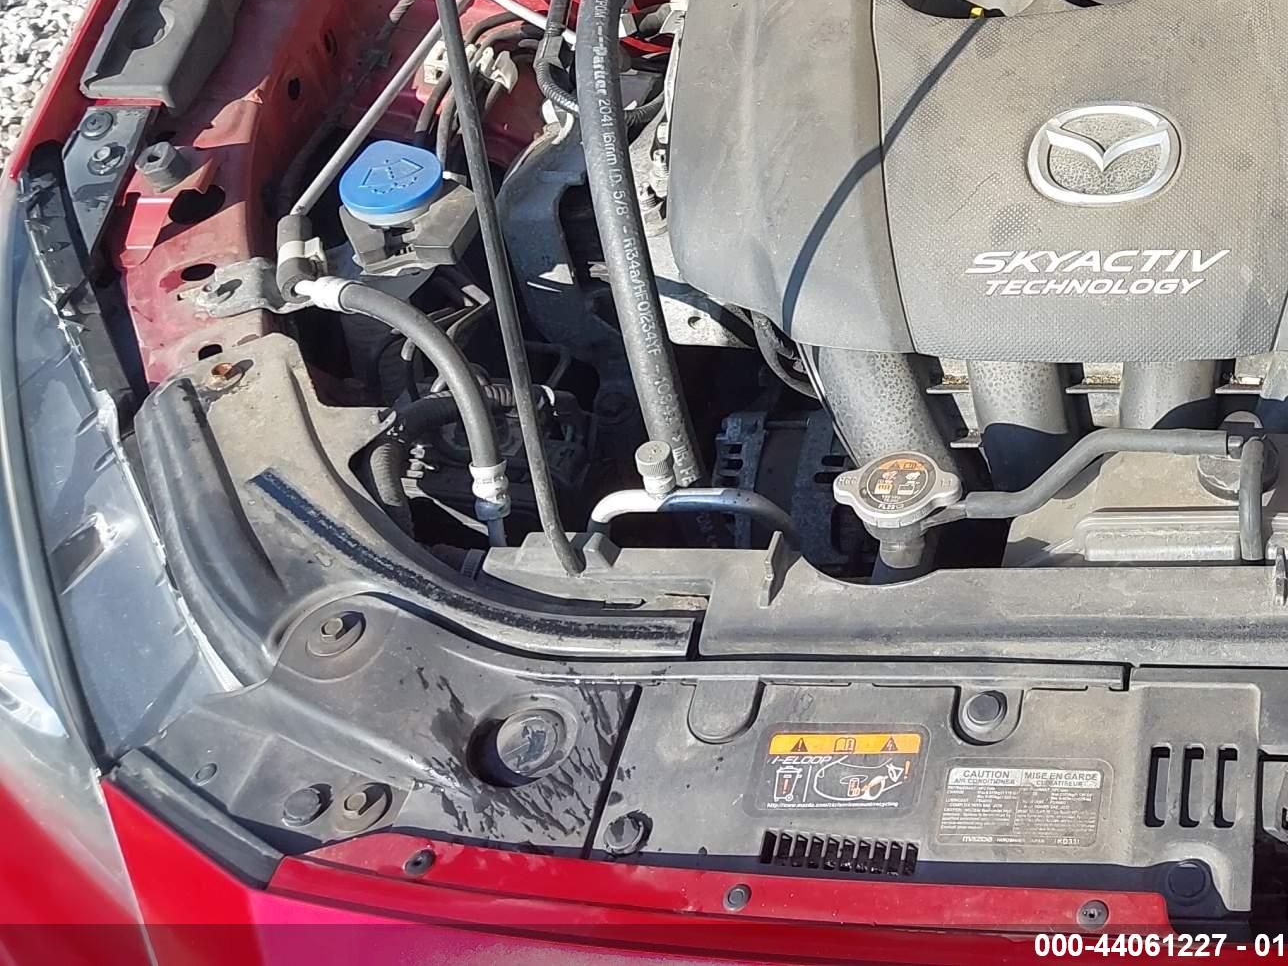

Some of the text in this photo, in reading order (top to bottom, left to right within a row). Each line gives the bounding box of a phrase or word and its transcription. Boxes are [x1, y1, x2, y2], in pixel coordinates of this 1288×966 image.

[598, 99, 614, 127] 2041
[602, 132, 617, 166] 16mm
[965, 249, 1230, 274] SKYACTIV
[985, 278, 1207, 297] TECHNOLOGY
[963, 769, 1010, 779] CAUTION
[1024, 771, 1098, 782] MISE EN GARDE
